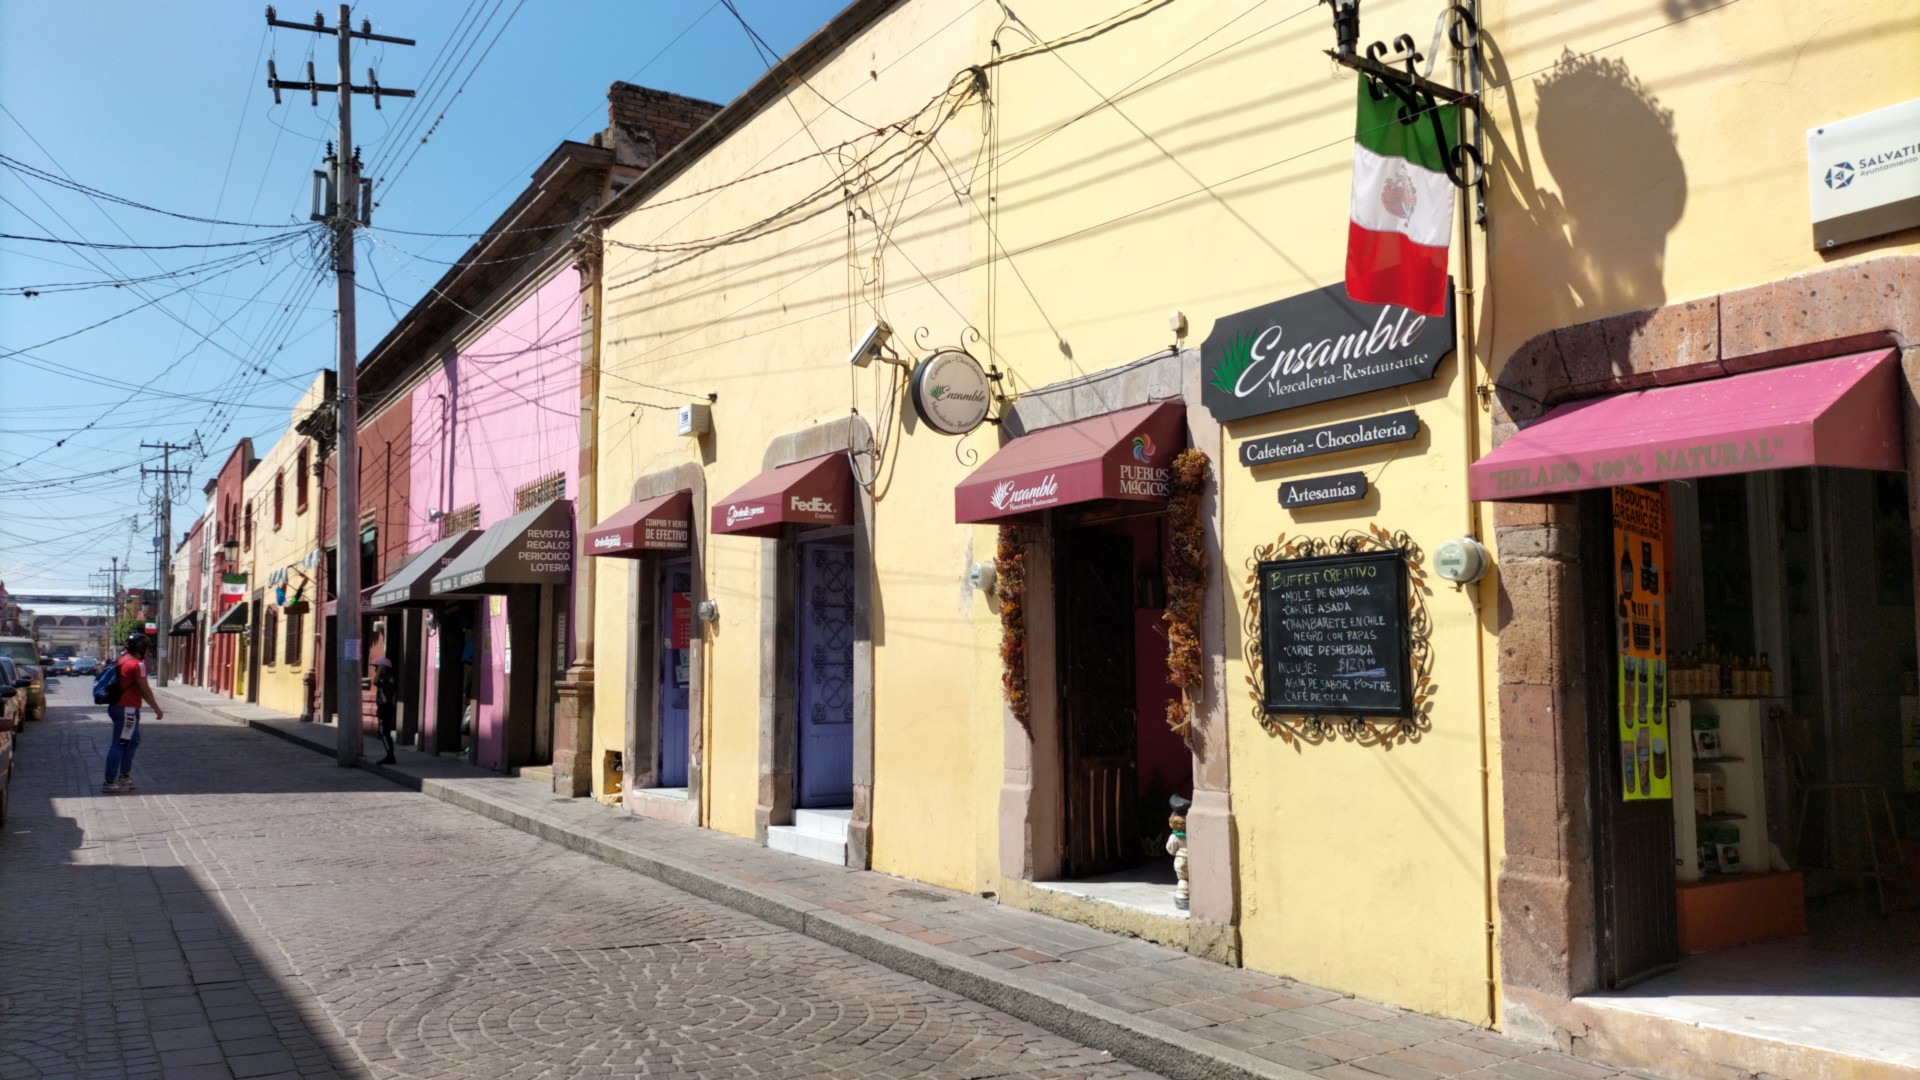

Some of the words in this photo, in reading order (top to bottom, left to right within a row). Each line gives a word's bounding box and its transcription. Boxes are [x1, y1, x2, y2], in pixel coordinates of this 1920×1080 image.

[1860, 156, 1918, 177] Ayuntamiento
[1234, 304, 1426, 398] Ensamble
[936, 385, 986, 402] Ensamble
[1246, 440, 1305, 461] Cafetería
[1315, 421, 1407, 449] Chocolatería
[1591, 454, 1644, 481] 100%
[998, 473, 1058, 510] Ensamble
[1286, 481, 1356, 504] Artesanías
[790, 495, 833, 513] FedEx
[1614, 486, 1660, 514] PRODUCTOS
[814, 512, 835, 520] Express
[645, 519, 667, 528] COMPRA
[668, 520, 672, 528] Y
[672, 520, 688, 529] VENTA
[527, 529, 571, 539] REVISTAS
[645, 528, 655, 540] DE
[656, 529, 688, 541] EFECTIVO
[526, 540, 571, 550] REGALOS
[518, 551, 571, 561] PERIODICO
[530, 563, 571, 572] LOTERIA
[1271, 571, 1320, 590] BUFFET
[1323, 565, 1377, 583] CREATIVO
[1285, 591, 1312, 602] MOLE
[1316, 588, 1328, 599] DE
[1329, 585, 1370, 599] GUAYABA
[1284, 604, 1314, 616] CARNE
[1318, 602, 1352, 614] ASADA
[1286, 617, 1348, 631] CHAMBARETE
[1293, 631, 1323, 643] NEGRO
[1327, 631, 1343, 641] CON
[1346, 630, 1378, 641] PAPAS
[1286, 645, 1314, 657] CARNE
[1308, 678, 1319, 690] DE
[1310, 692, 1321, 702] DE
[1323, 693, 1348, 703] OLLA
